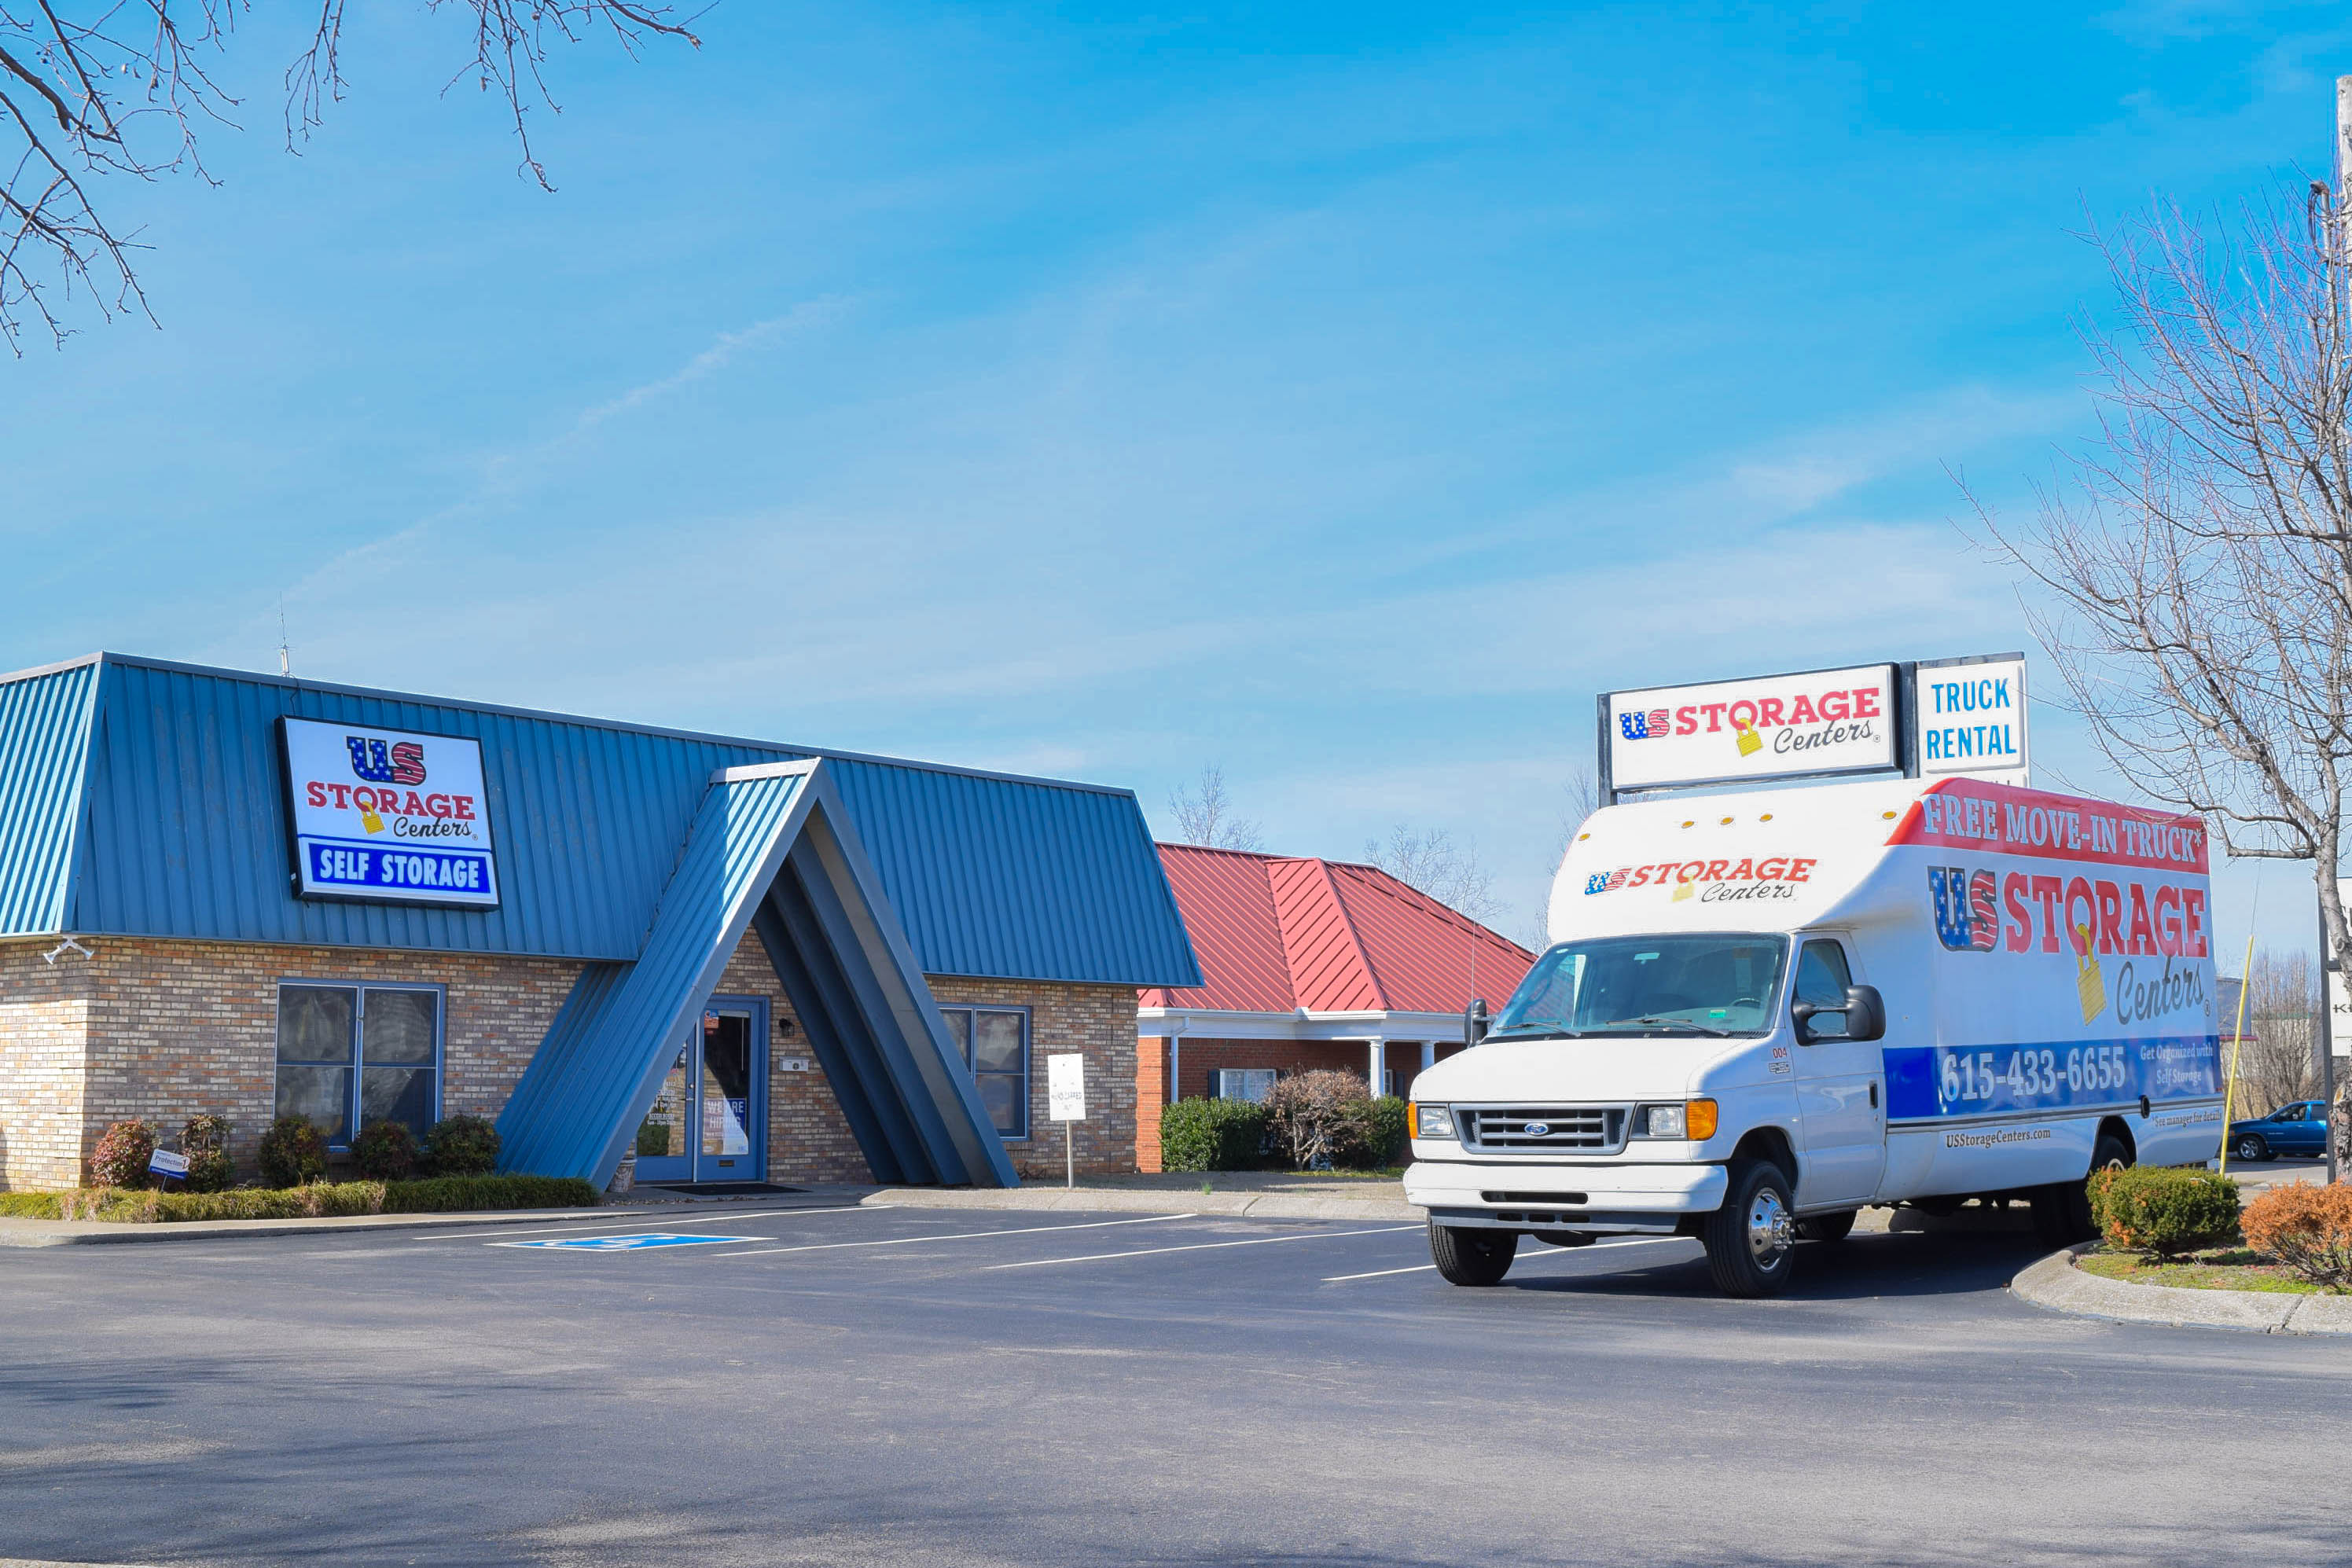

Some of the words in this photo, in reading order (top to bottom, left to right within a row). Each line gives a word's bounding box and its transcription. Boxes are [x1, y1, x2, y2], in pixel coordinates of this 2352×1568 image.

[1619, 708, 1670, 740] US
[1675, 687, 1880, 736] STORAGE
[1931, 678, 2010, 714] TRUCK
[1773, 719, 1873, 753] Centers
[1927, 724, 2017, 759] RENTAL
[346, 736, 427, 786] US
[307, 781, 476, 821] STORAGE
[393, 817, 472, 838] Centers
[1924, 793, 1998, 840] FREE
[2005, 803, 2117, 854] MOVE-IN
[320, 849, 369, 881] SELF
[381, 854, 479, 888] STORAGE
[1627, 857, 1817, 887] STORAGE
[1701, 879, 1794, 903] Centers
[1928, 865, 2000, 953] US
[2004, 871, 2208, 958] STORAGE
[2116, 955, 2204, 1025] Centers
[2141, 1045, 2155, 1061] Get
[2156, 1043, 2196, 1063] Organized
[2196, 1042, 2214, 1057] with
[1941, 1046, 2126, 1102] 615-433-6655
[2156, 1069, 2172, 1086] Self
[2172, 1068, 2202, 1086] Storage
[1946, 1128, 2051, 1149] USStorageCenters.com
[154, 1155, 183, 1167] Protection
